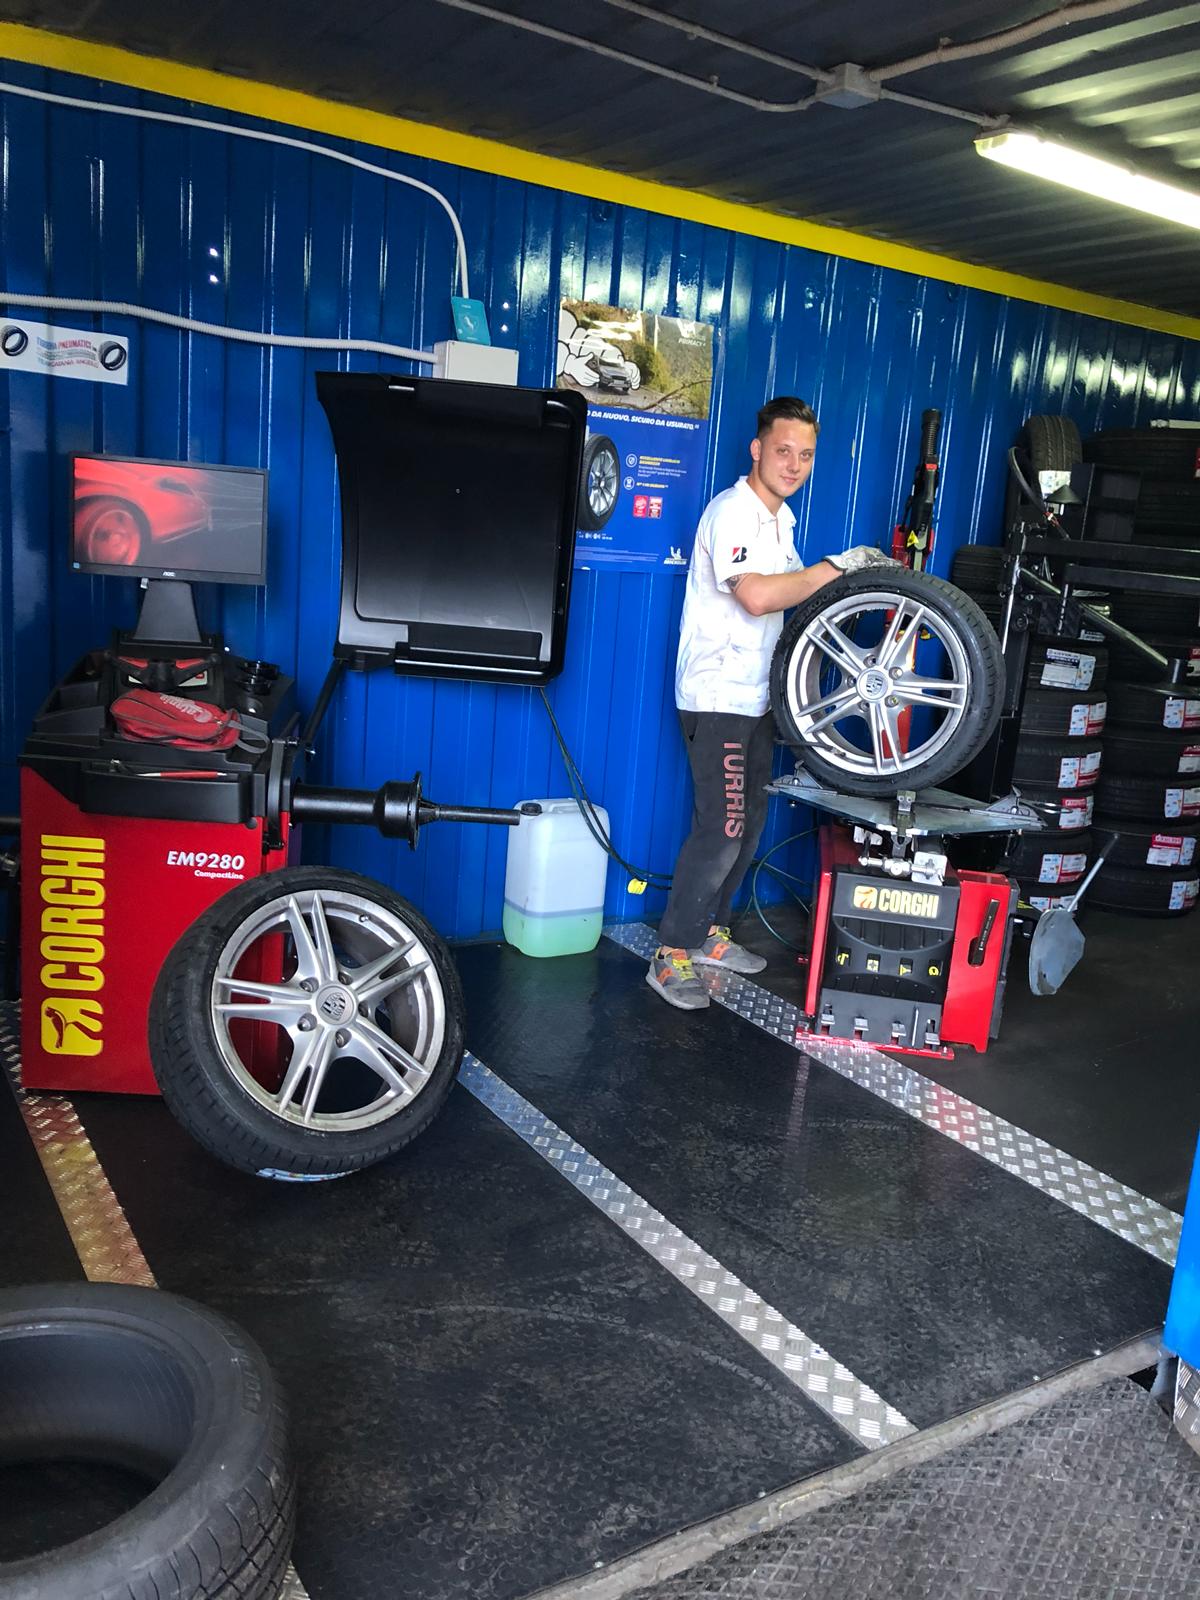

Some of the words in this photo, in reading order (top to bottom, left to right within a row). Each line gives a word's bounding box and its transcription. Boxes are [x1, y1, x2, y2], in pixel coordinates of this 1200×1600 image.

[591, 410, 602, 418] DA
[602, 412, 630, 422] NUOVO,
[631, 415, 655, 425] SICURO
[166, 850, 245, 870] EM9280
[194, 869, 244, 880] CompactLine
[40, 834, 106, 992] CORGHI
[878, 888, 940, 919] CORGHI
